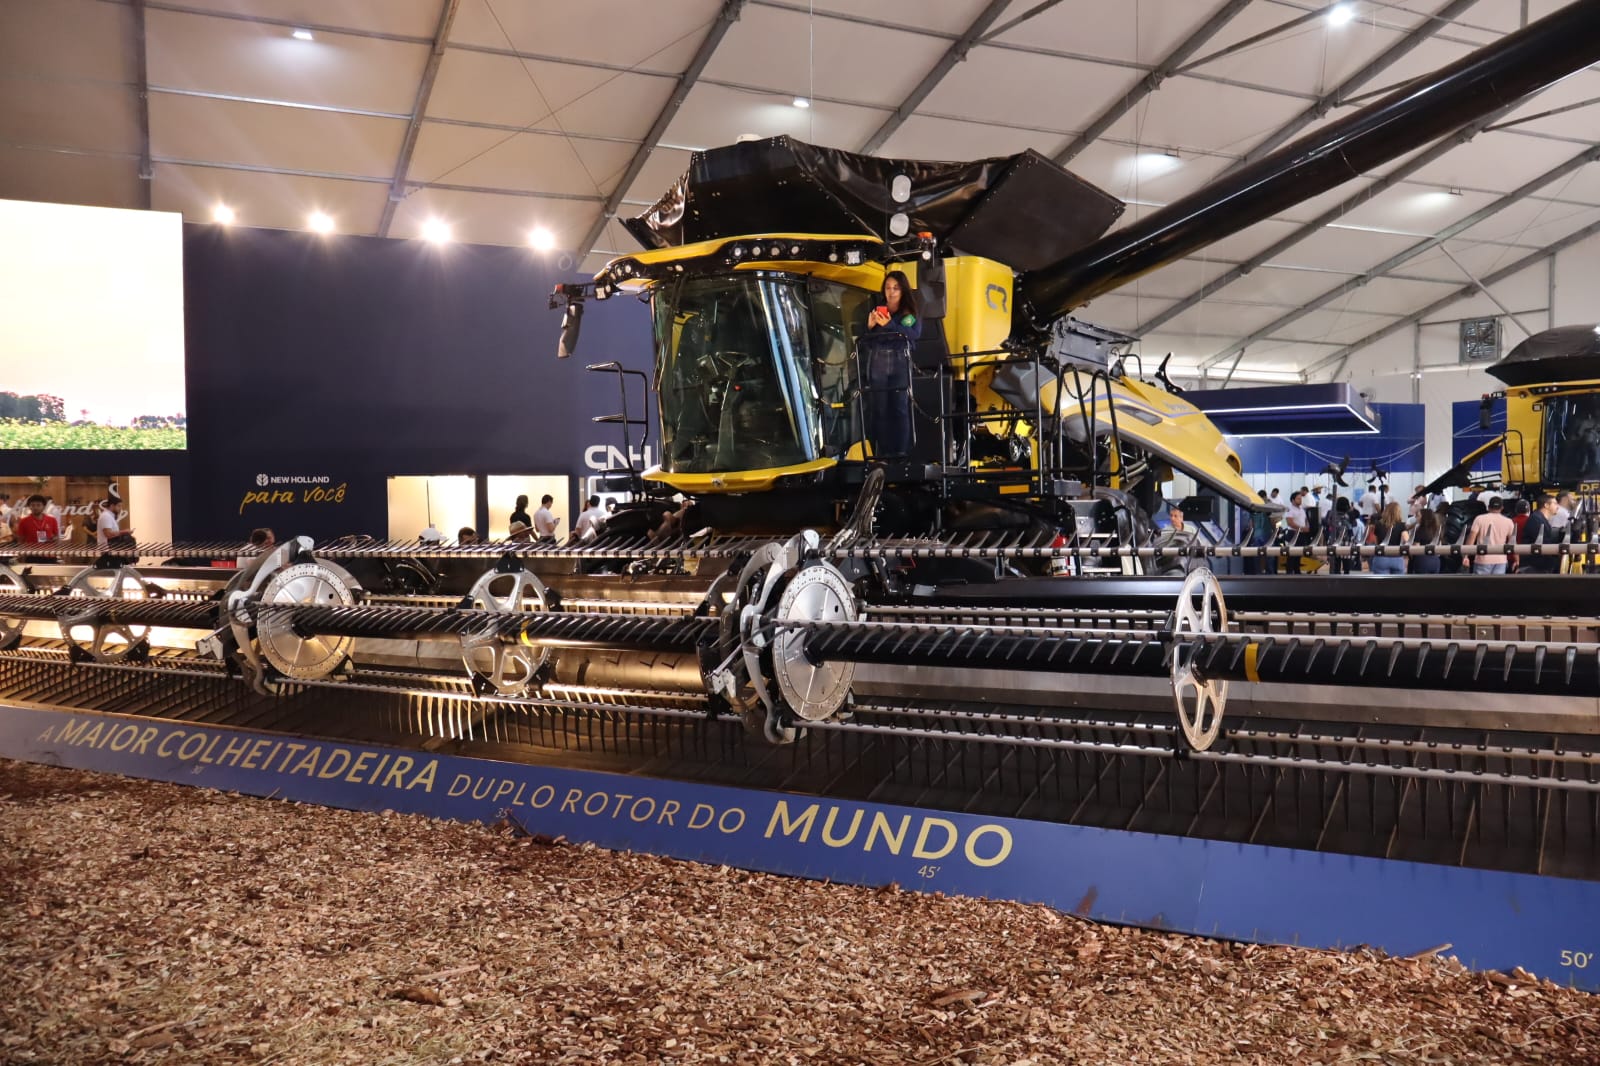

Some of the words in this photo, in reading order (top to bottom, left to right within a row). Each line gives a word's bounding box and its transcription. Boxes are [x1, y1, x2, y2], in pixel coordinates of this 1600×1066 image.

[584, 445, 652, 470] CNH
[270, 476, 290, 484] NEW
[290, 476, 330, 484] HOLLAND
[239, 490, 295, 515] para
[303, 482, 348, 503] você
[37, 724, 57, 743] A
[54, 718, 159, 755] MAIOR
[156, 730, 439, 793] COLHEITADEIRA
[447, 773, 556, 809] DUPLO
[559, 788, 681, 826] ROTOR
[687, 803, 747, 833] DO
[764, 800, 1013, 867] MUNDO
[917, 865, 941, 879] 45'
[1560, 949, 1594, 969] 50'
